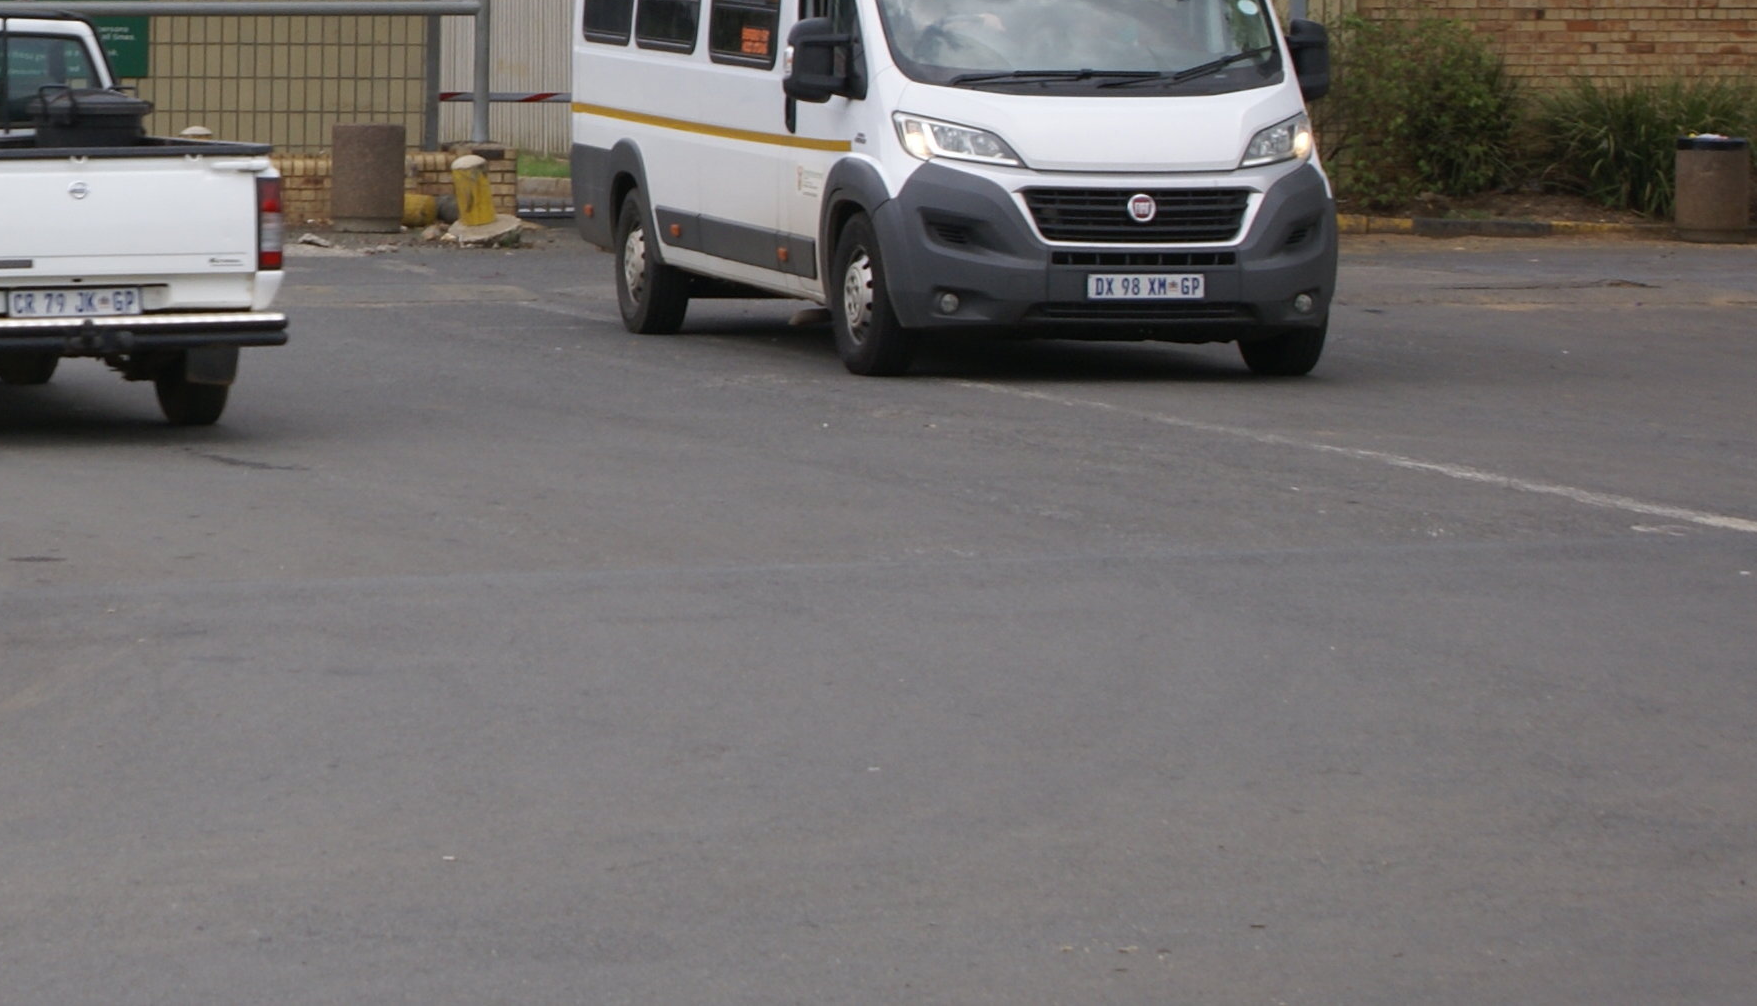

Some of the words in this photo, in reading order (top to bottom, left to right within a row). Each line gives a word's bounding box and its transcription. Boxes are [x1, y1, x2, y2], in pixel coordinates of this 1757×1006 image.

[1094, 277, 1114, 295] DX
[1121, 277, 1141, 295] 98
[1147, 277, 1167, 295] XM
[1180, 277, 1200, 295] GP
[13, 293, 36, 313] CR
[44, 293, 66, 313] 79
[75, 292, 98, 313] JK
[113, 290, 134, 312] GP
